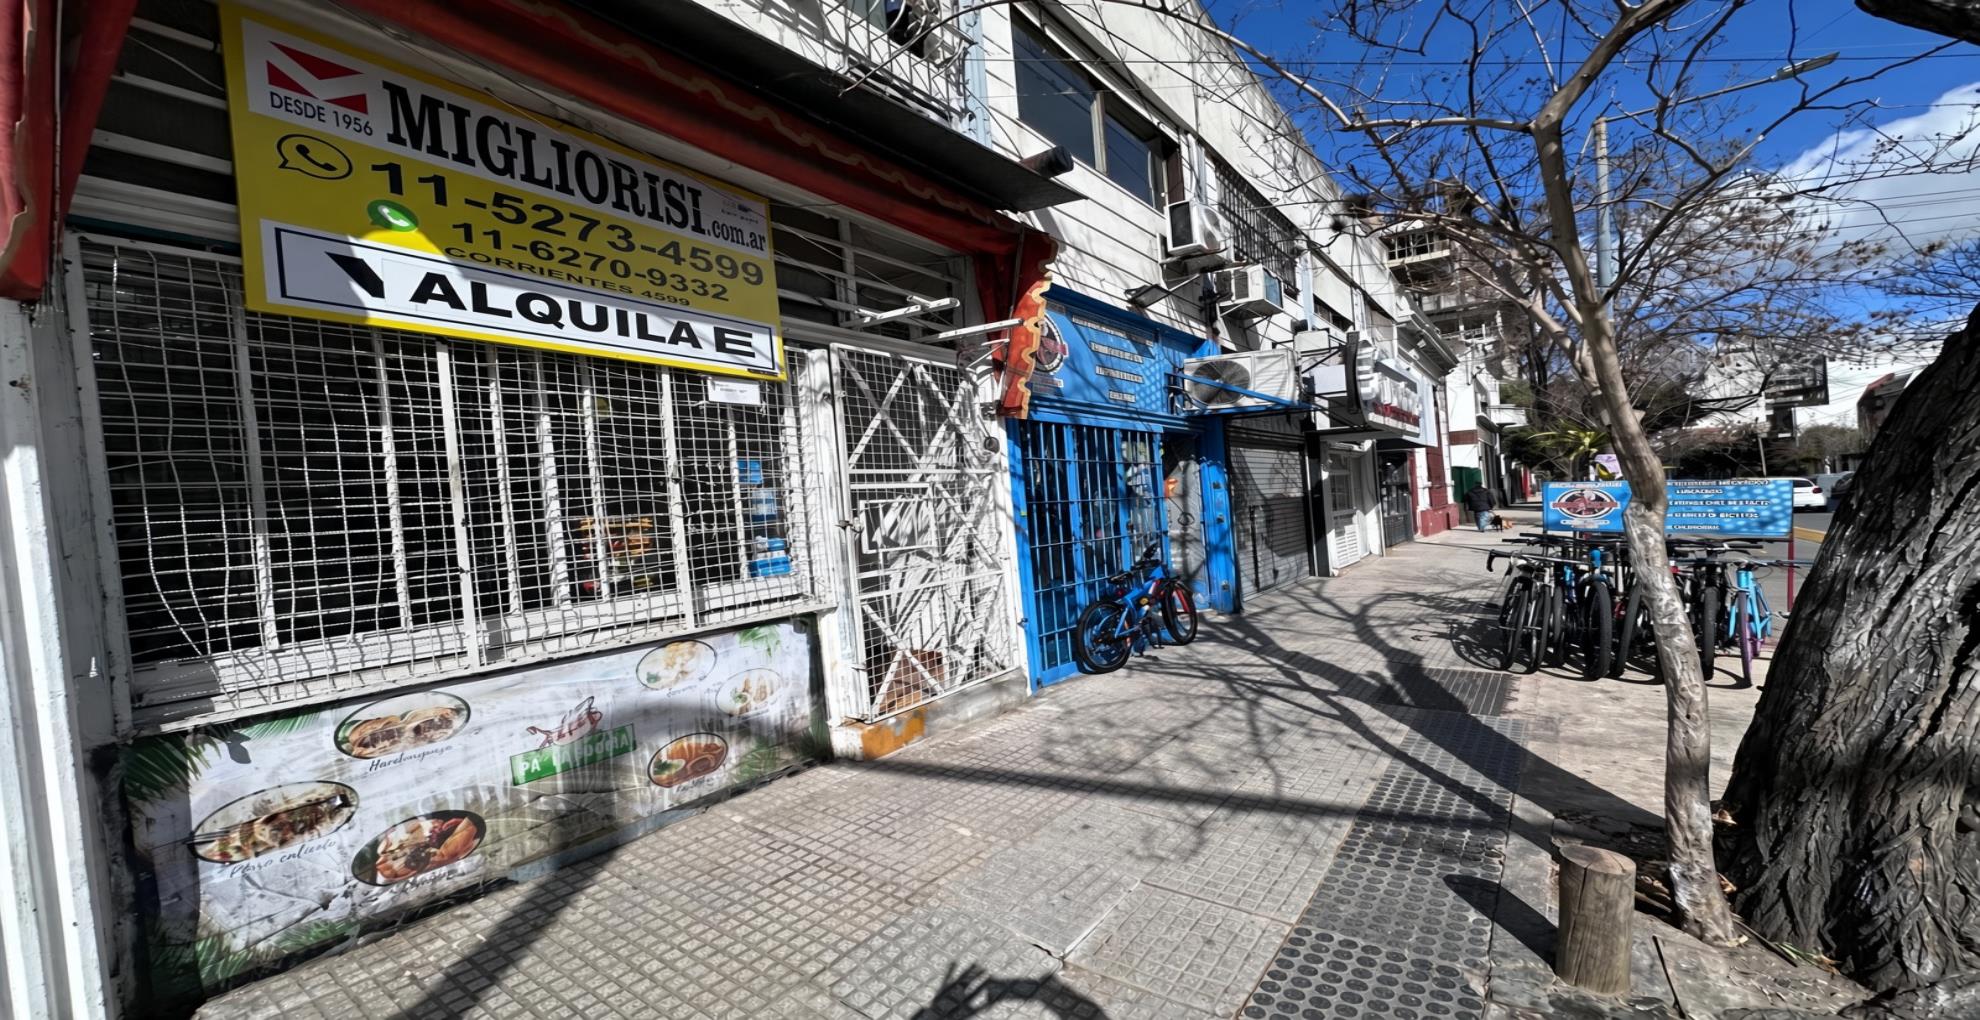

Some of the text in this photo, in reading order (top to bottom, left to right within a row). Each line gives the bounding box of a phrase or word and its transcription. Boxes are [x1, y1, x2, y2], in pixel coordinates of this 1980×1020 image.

[269, 91, 373, 136] DESDE 1956
[371, 162, 764, 286] 11-5273-4599
[444, 247, 690, 306] CORRIENTES 4599
[452, 222, 729, 302] 11-6270-9332
